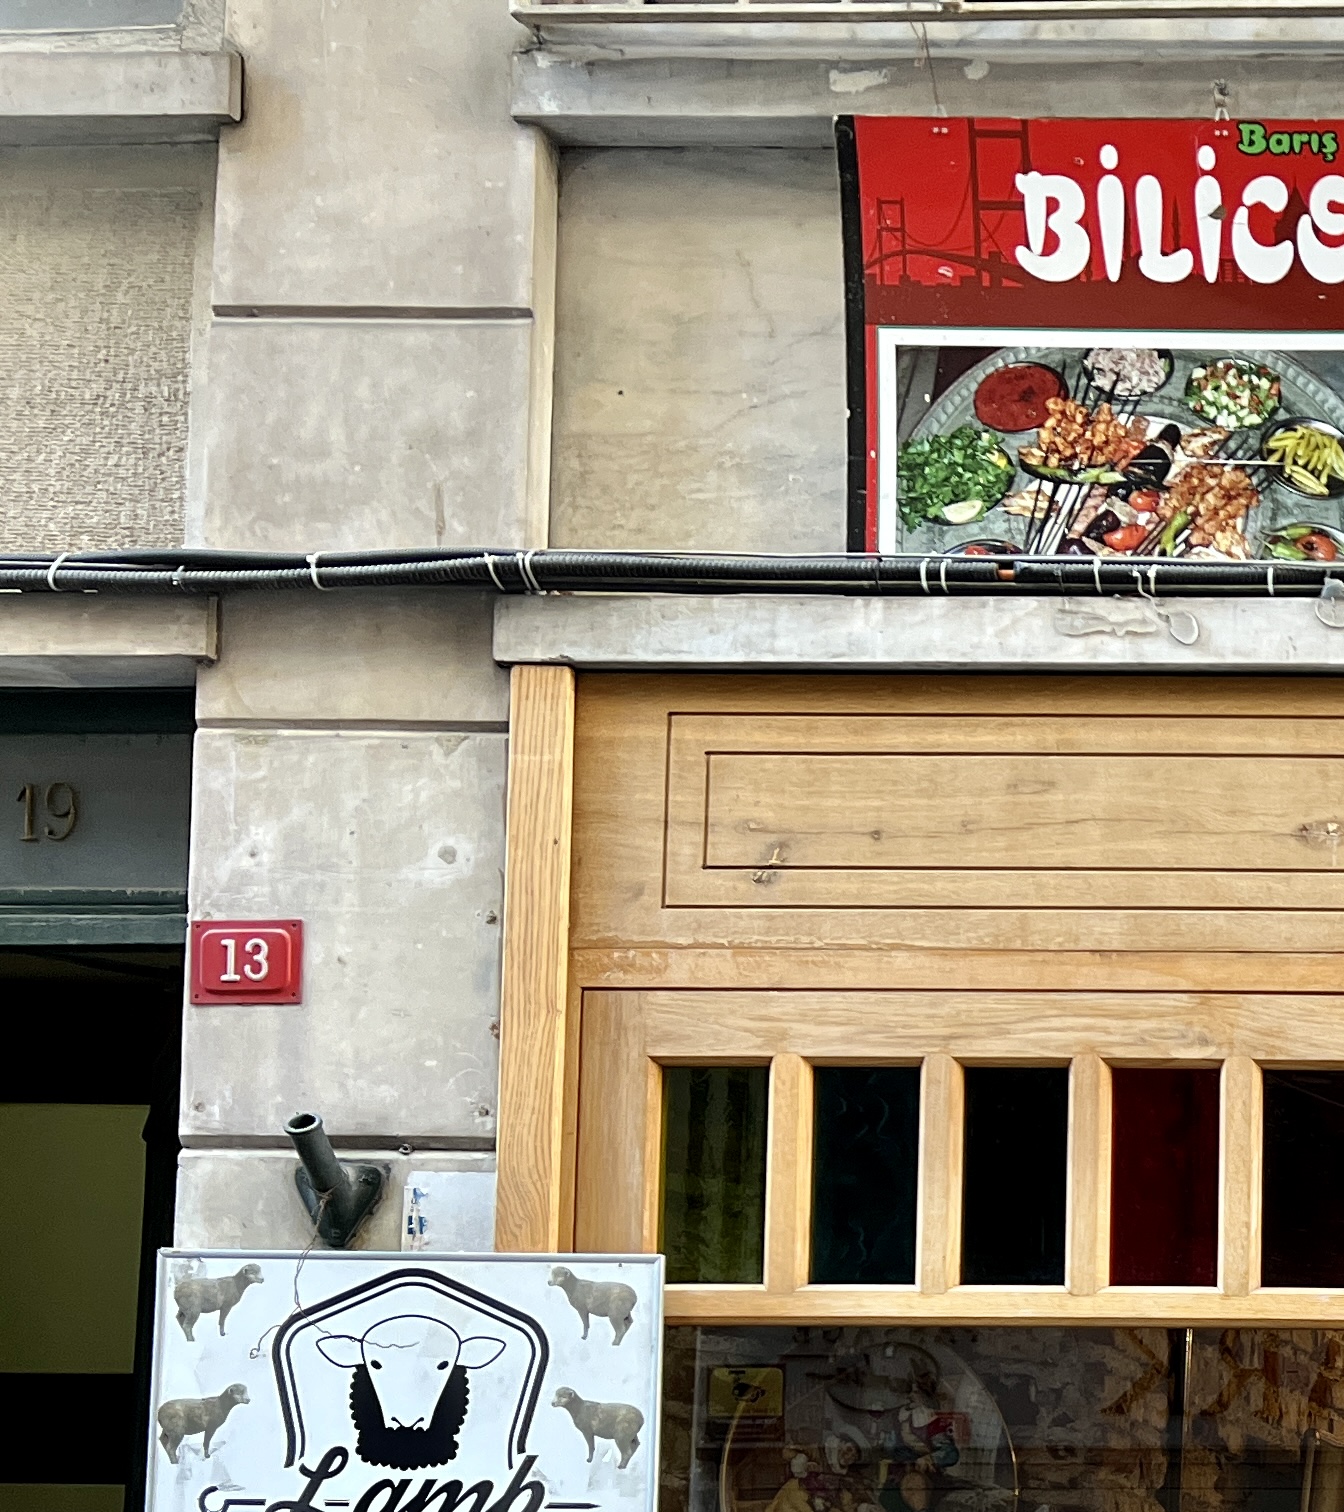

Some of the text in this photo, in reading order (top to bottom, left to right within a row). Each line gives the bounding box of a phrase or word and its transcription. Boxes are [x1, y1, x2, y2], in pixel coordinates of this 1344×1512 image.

[1238, 122, 1337, 162] Barış
[16, 781, 79, 843] 19
[219, 937, 270, 982] 13
